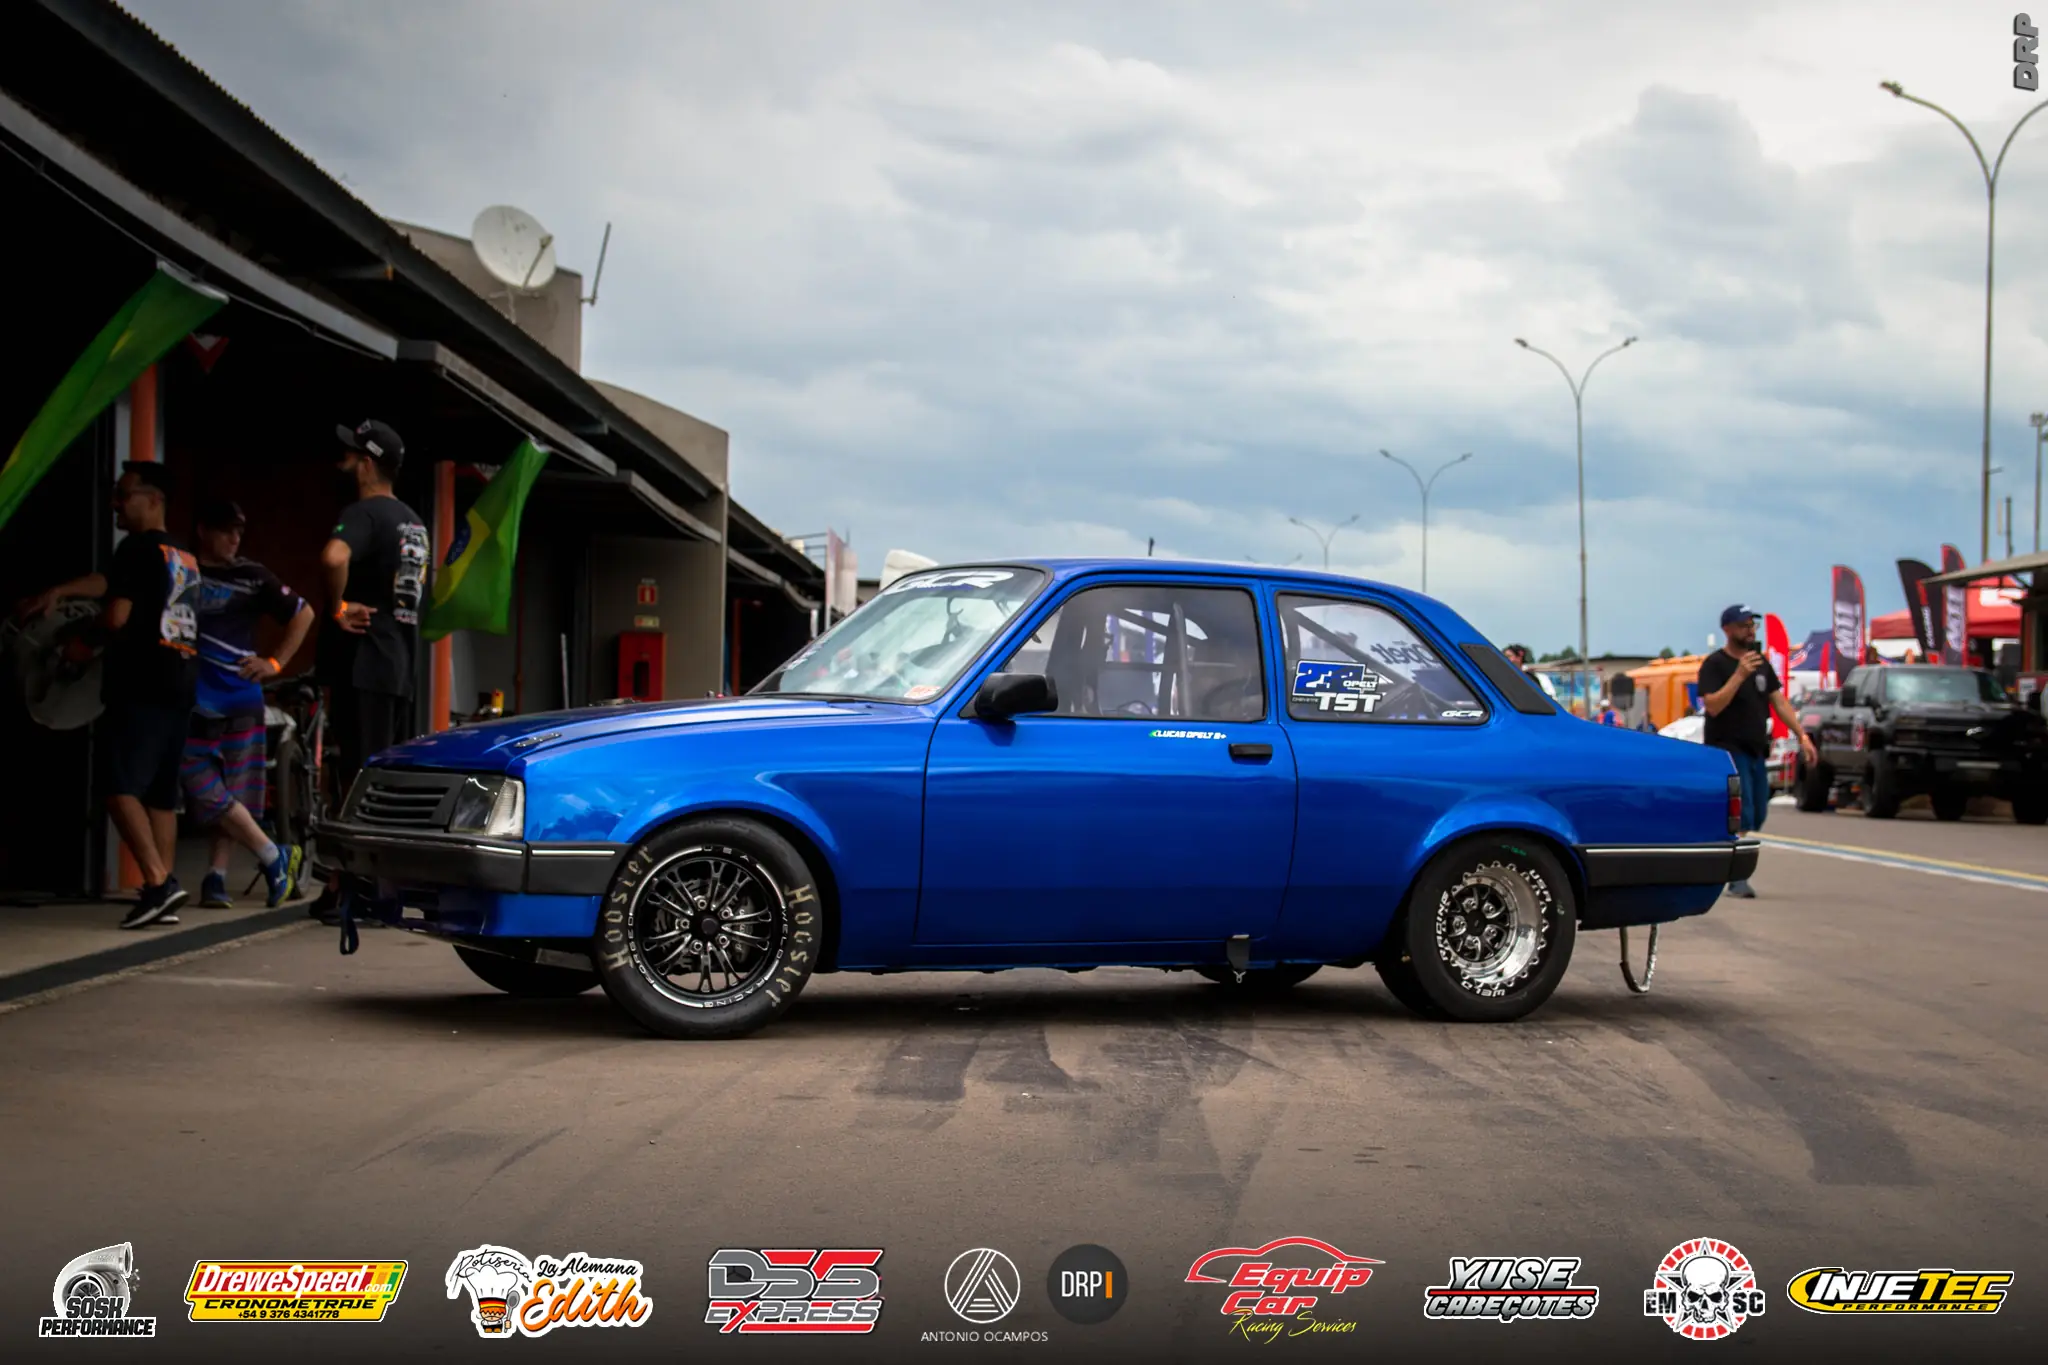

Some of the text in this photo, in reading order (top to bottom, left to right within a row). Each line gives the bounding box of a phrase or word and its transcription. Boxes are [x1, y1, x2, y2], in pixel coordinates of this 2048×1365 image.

[1314, 692, 1381, 712] TST
[1157, 730, 1186, 738] LUCAS
[1529, 869, 1552, 902] USA
[1436, 891, 1451, 960] RACING
